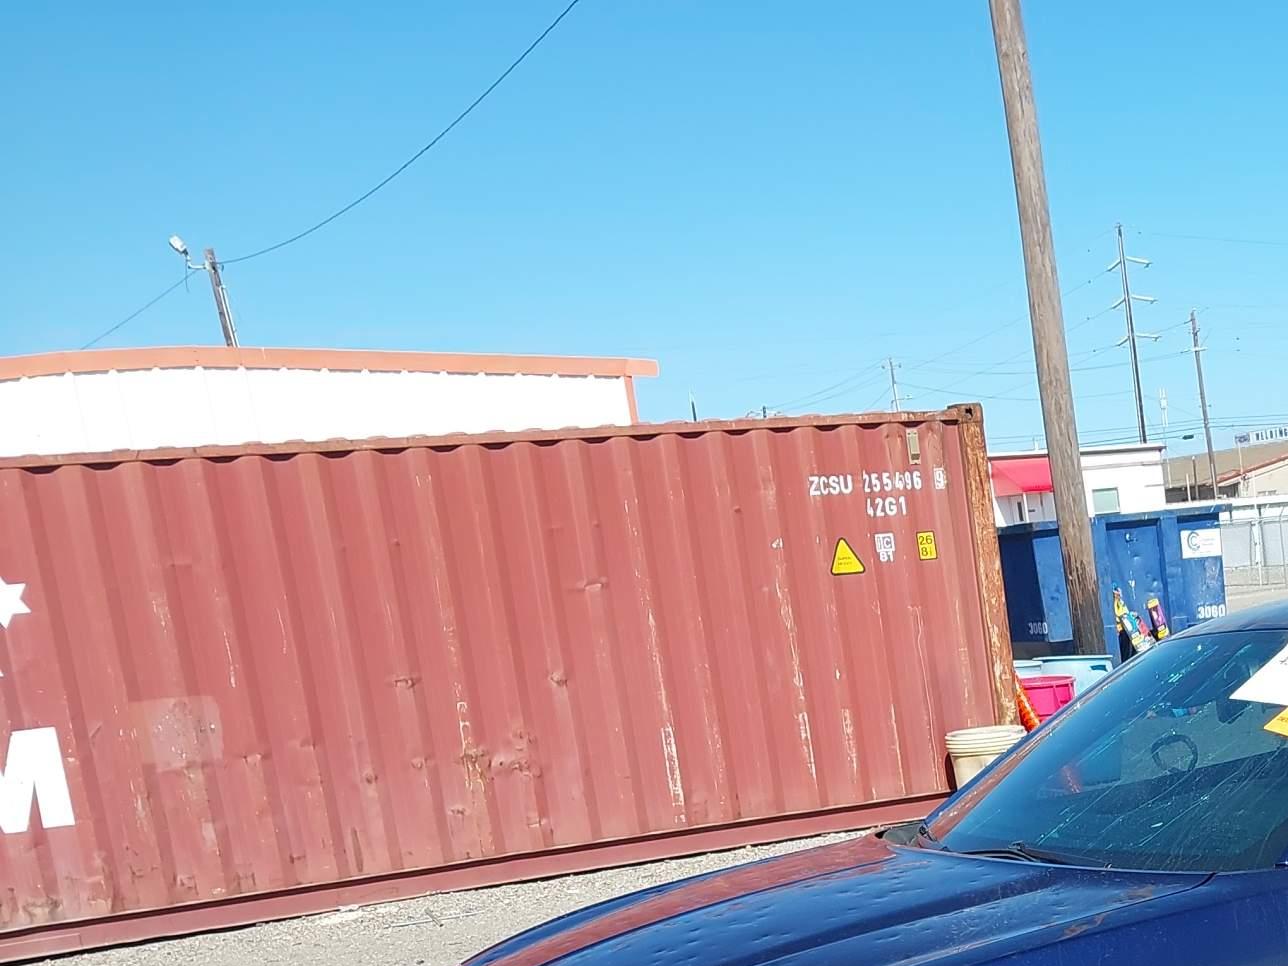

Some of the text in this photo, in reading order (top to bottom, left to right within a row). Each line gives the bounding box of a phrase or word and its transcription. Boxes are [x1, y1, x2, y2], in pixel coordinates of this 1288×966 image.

[1255, 428, 1288, 441] WELDING
[808, 474, 853, 496] ZCSU
[862, 470, 922, 493] 255496
[866, 496, 907, 517] 42G1
[919, 535, 932, 546] 26
